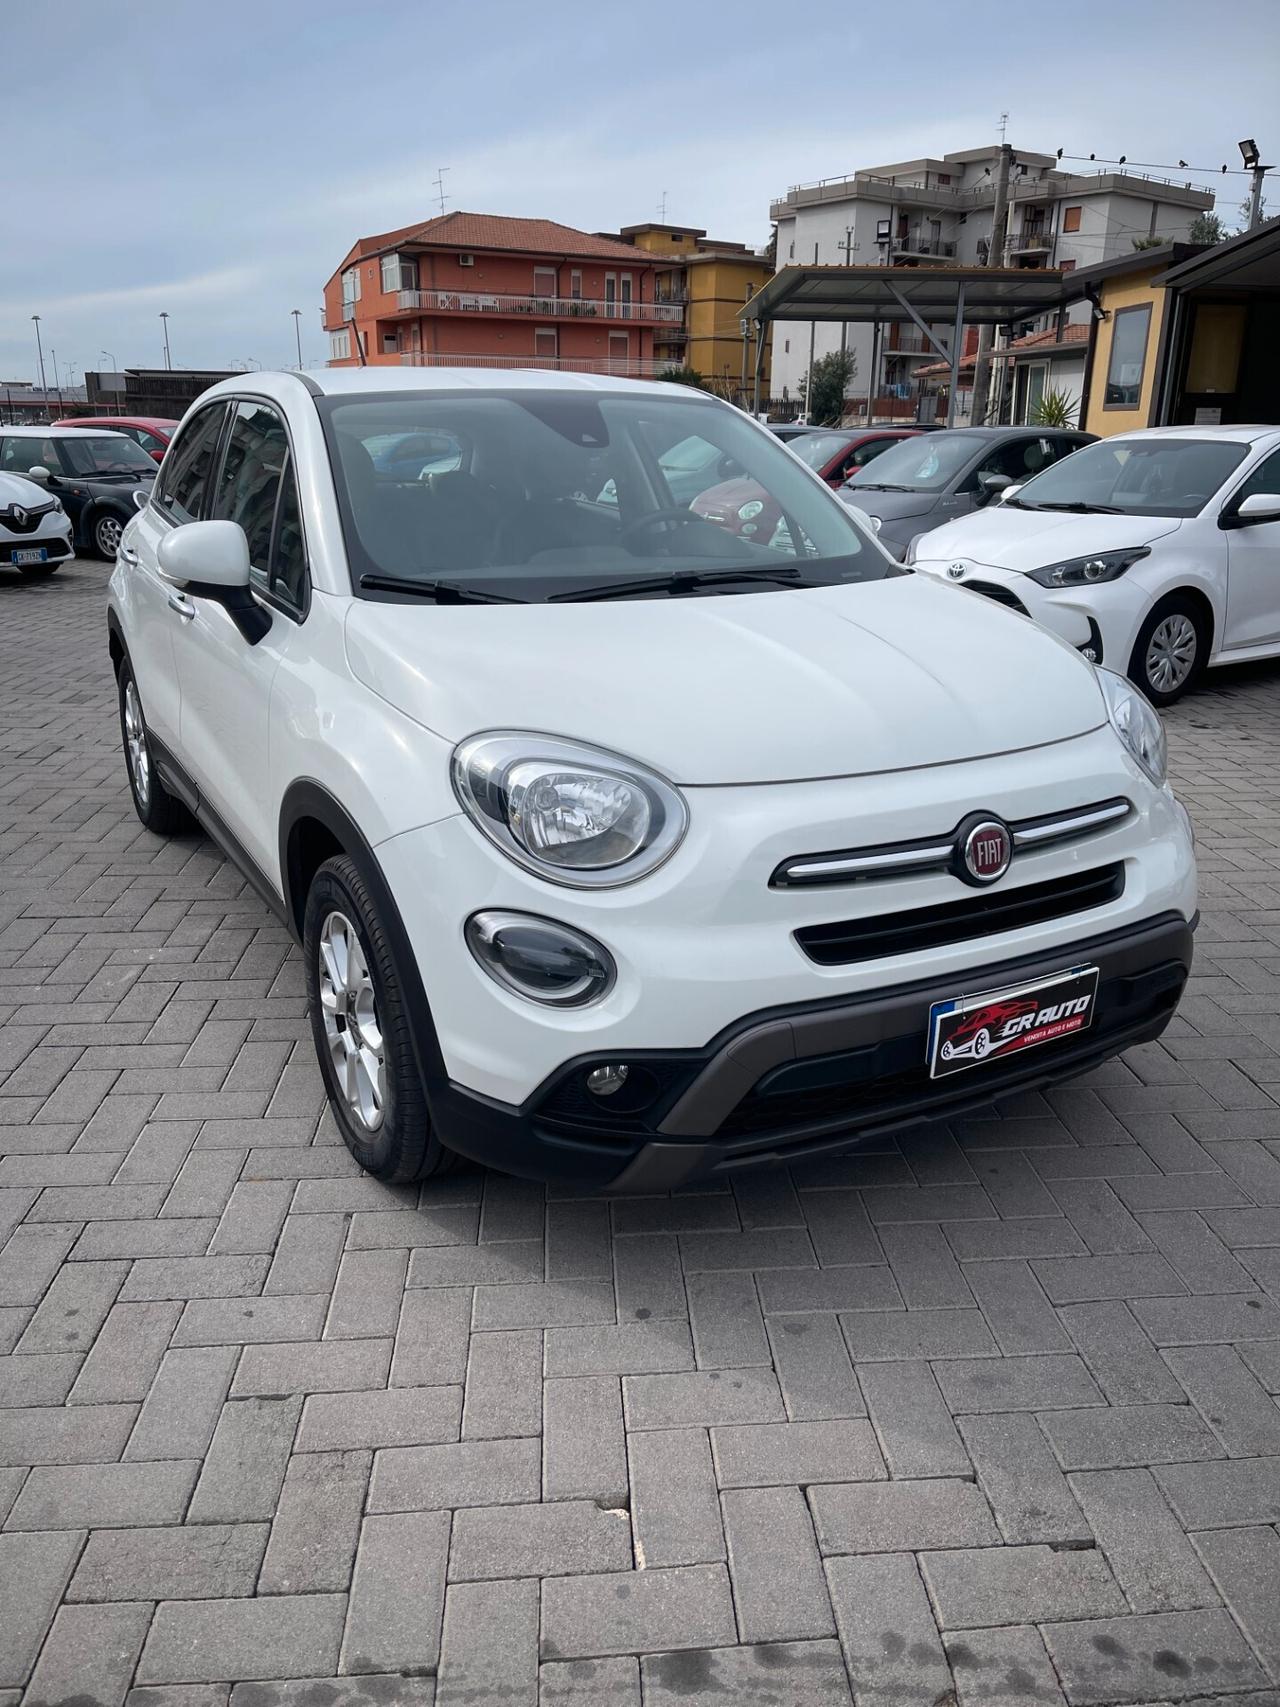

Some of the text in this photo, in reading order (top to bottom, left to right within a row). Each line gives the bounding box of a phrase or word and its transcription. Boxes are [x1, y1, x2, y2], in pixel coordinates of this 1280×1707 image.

[977, 838, 1002, 867] FIAT
[1002, 994, 1091, 1037] GR AUTO
[1024, 1030, 1046, 1043] VENDITA
[1047, 1025, 1061, 1035] AUTO
[1066, 1019, 1082, 1029] MOTO
